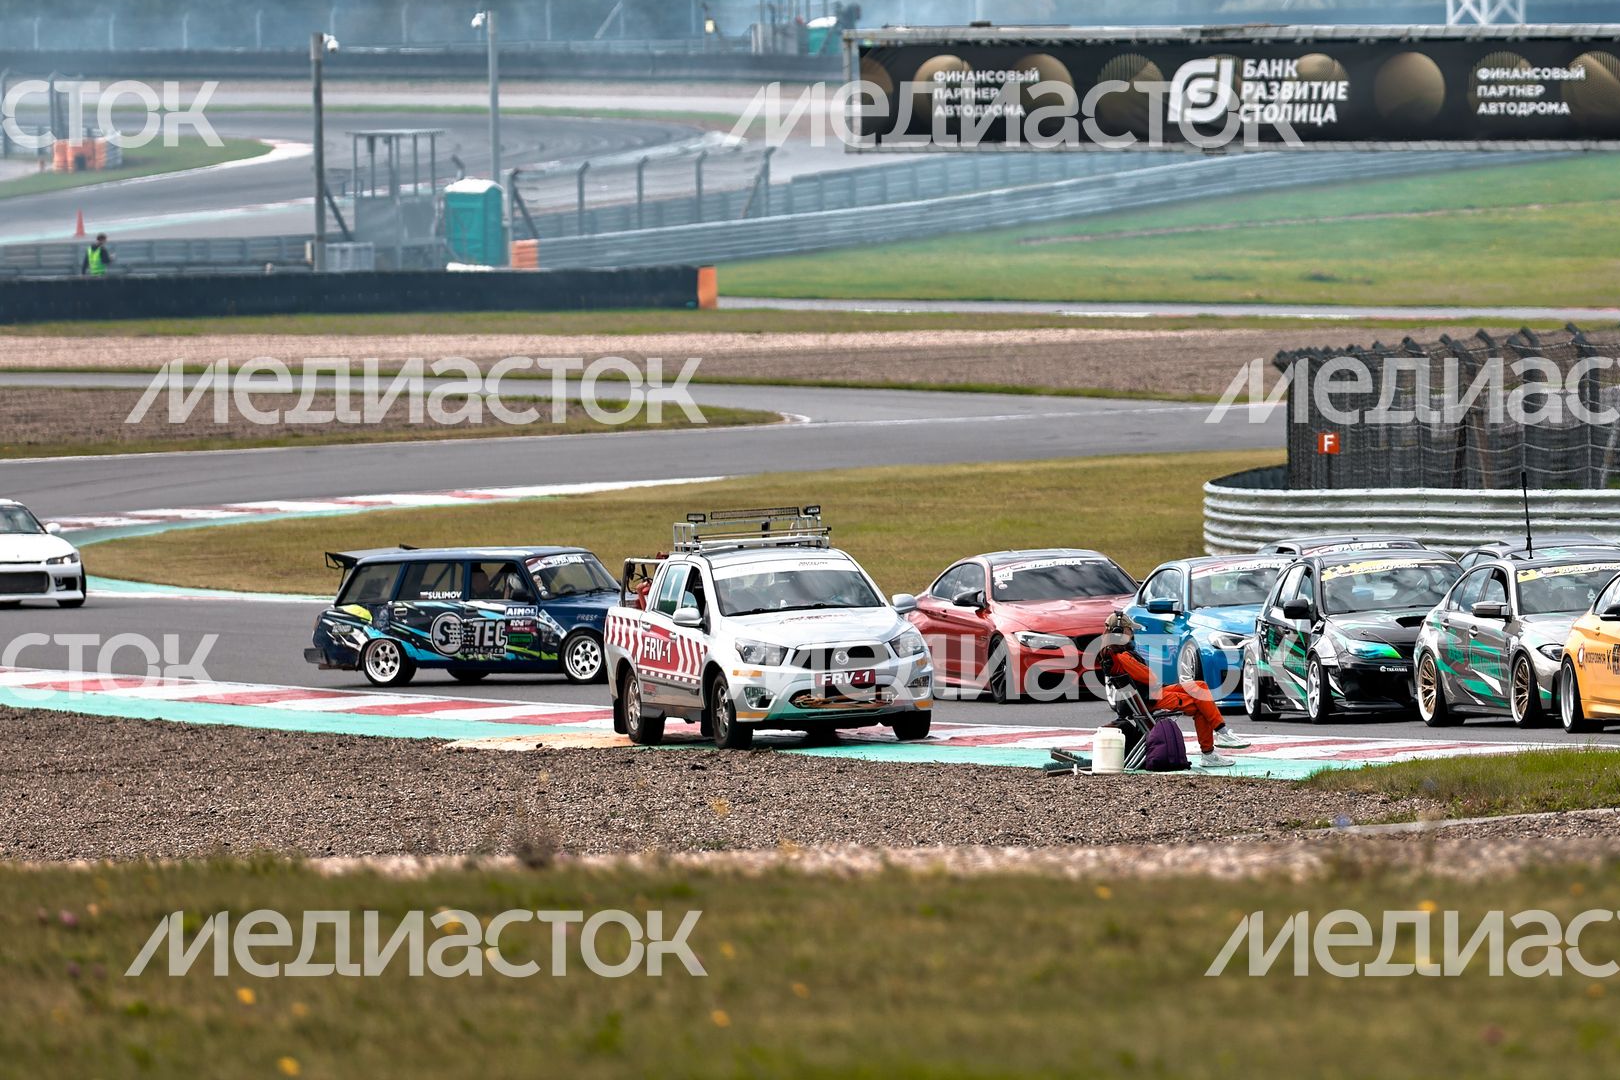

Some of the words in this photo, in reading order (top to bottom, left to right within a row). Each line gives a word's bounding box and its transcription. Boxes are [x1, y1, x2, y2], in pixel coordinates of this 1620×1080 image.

[933, 68, 1040, 83] ФИНАНСОВЫЙ
[1242, 58, 1299, 80] БАНК
[1476, 65, 1586, 81] ФИНАНСОВЫЙ
[932, 86, 999, 101] ПАРТНЕР
[1240, 81, 1349, 102] РАЗВИТИЕ
[1476, 84, 1546, 98] ПАРТНЕР
[933, 103, 1027, 119] АВТОДРОМА
[1237, 102, 1338, 126] СТОЛИЦА
[1476, 101, 1571, 117] АВТОДРОМА
[1323, 434, 1335, 452] F
[427, 590, 463, 600] SULIMOV
[643, 636, 673, 665] FRV-1
[820, 670, 872, 687] FRV-1
